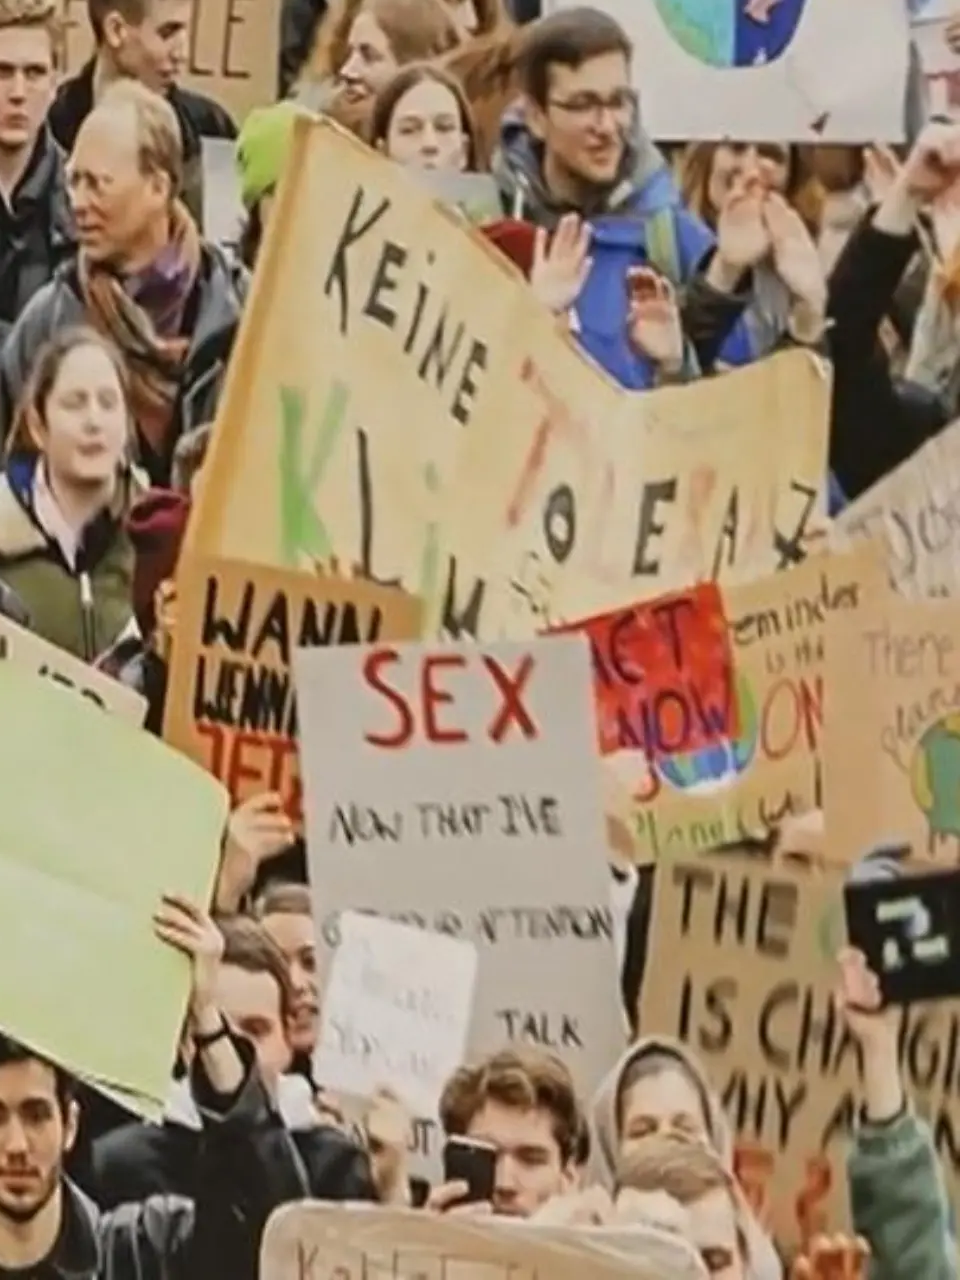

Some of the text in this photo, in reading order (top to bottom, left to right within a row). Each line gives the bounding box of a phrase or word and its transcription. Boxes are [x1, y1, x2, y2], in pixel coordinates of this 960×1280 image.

[201, 574, 383, 666] WANN
[734, 572, 858, 646] eminder
[362, 650, 537, 748] SEX
[616, 685, 728, 757] NOW
[329, 800, 404, 848] NOW
[414, 799, 488, 839] THAT
[672, 864, 799, 961] THE
[496, 1009, 583, 1048] TALK
[677, 972, 738, 1051] IS
